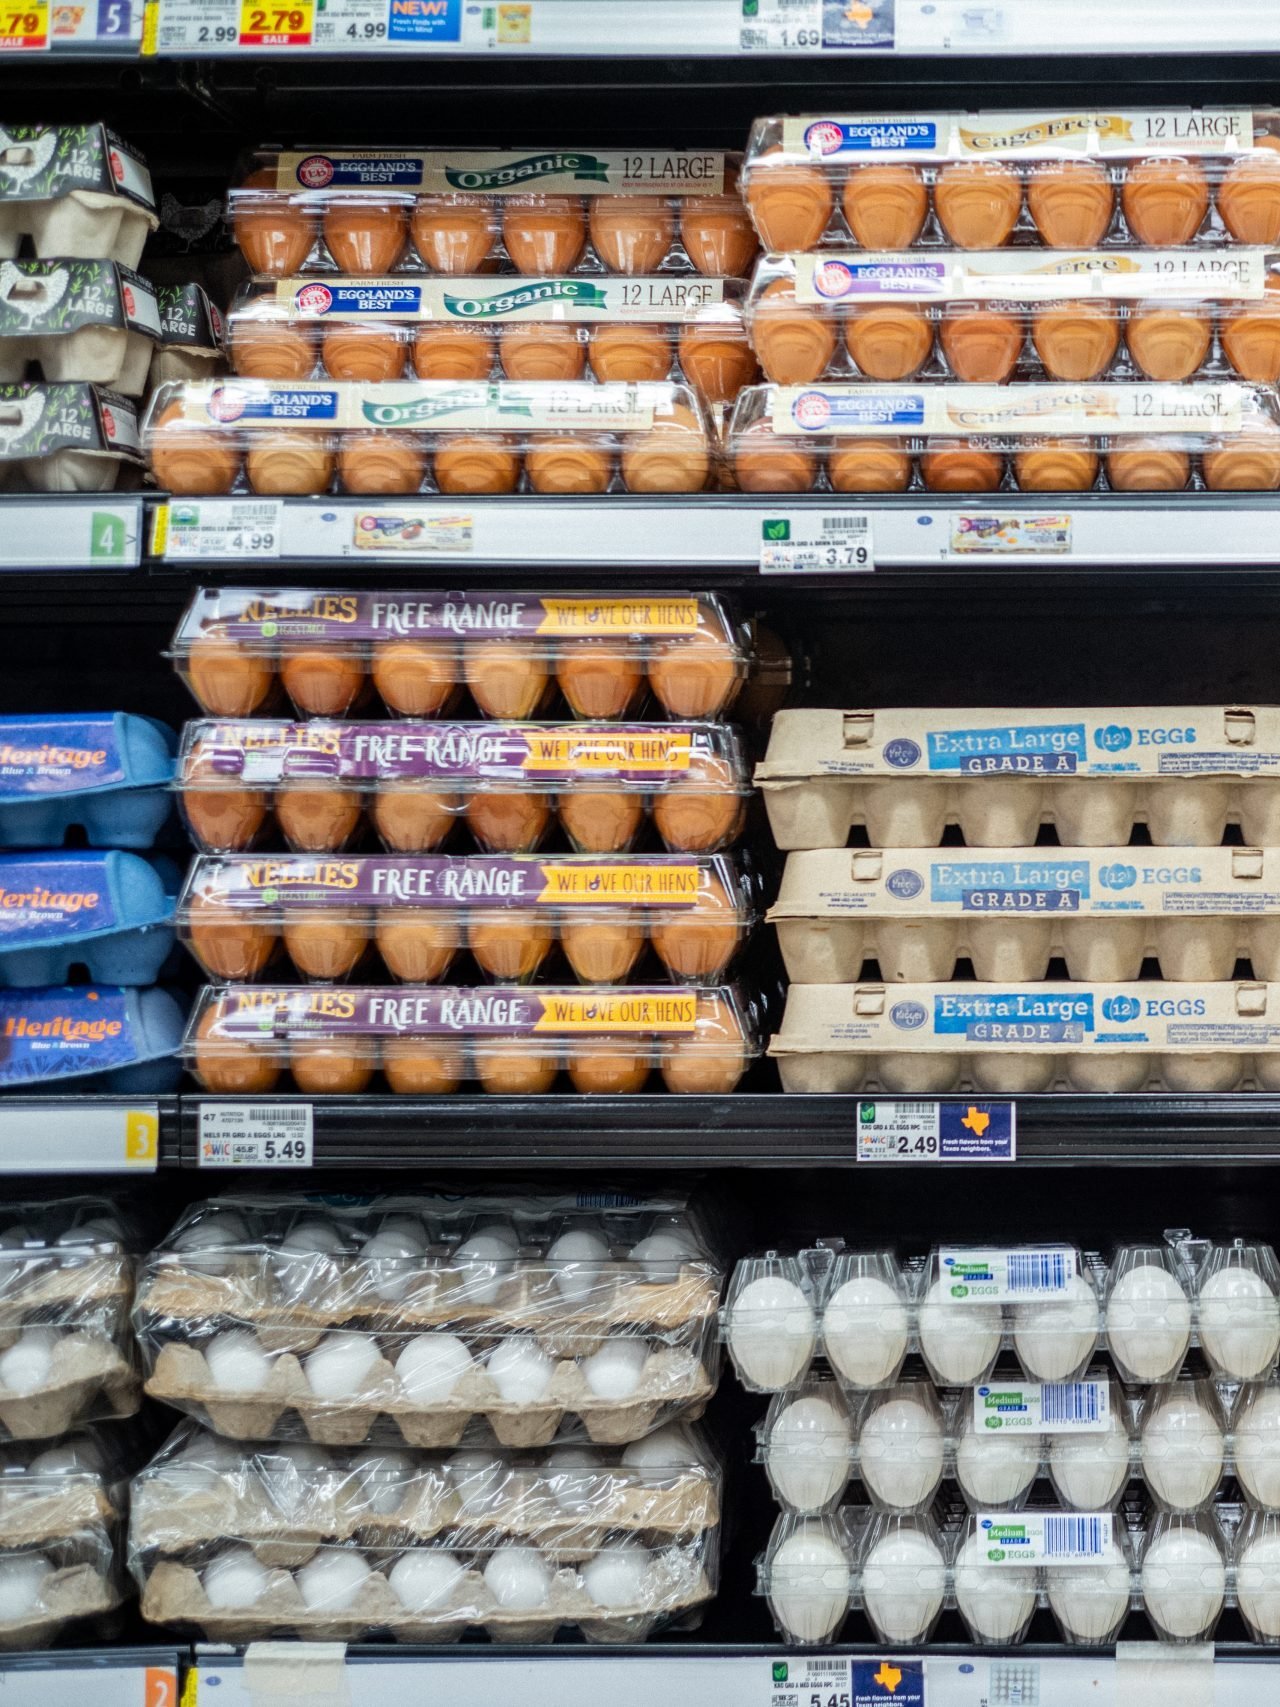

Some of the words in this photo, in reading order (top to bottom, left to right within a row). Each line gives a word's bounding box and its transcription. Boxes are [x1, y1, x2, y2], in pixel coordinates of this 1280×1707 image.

[392, 1, 447, 16] NEW!
[106, 3, 121, 33] 5
[250, 10, 304, 31] 2.79
[198, 27, 237, 42] 2.99
[262, 35, 289, 44] SALE
[346, 23, 386, 38] 4.99
[781, 29, 820, 46] 1.69
[1145, 118, 1166, 138] 12
[1173, 117, 1243, 138] LARGE
[870, 137, 908, 147] BEST
[71, 150, 89, 166] 12
[55, 163, 103, 182] LARGE
[457, 155, 580, 188] Organic
[622, 157, 643, 179] 12
[650, 156, 716, 179] LARGE
[359, 172, 395, 182] BEST
[83, 286, 101, 301] 12
[68, 298, 115, 318] LARGE
[60, 408, 78, 422] 12
[43, 422, 92, 440] LARGE
[99, 524, 114, 550] 4
[232, 533, 274, 551] 4.99
[825, 546, 868, 565] 3.79
[371, 603, 432, 635] FREE
[441, 601, 525, 634] RANGE
[933, 733, 1001, 753] Extra
[1008, 729, 1081, 750] Large
[1105, 732, 1122, 744] 12
[1137, 728, 1196, 745] EGGS
[969, 757, 1044, 772] GRADE
[1056, 756, 1070, 771] A
[372, 868, 433, 900] FREE
[443, 866, 527, 901] RANGE
[556, 874, 577, 891] WE
[623, 873, 652, 892] OUR
[659, 873, 696, 892] HENS
[369, 998, 430, 1030] FREE
[440, 997, 523, 1030] RANGE
[555, 1002, 575, 1022] WE
[620, 1002, 649, 1021] OUR
[656, 1001, 692, 1021] HENS
[941, 998, 1011, 1017] Extra
[1016, 996, 1088, 1020] Large
[1112, 1003, 1131, 1015] 12
[1145, 999, 1206, 1016] EGGS
[5, 1017, 122, 1041] Heritage
[974, 1023, 1050, 1038] GRADE
[1062, 1022, 1076, 1038] A
[31, 1041, 51, 1050] Blue
[59, 1041, 90, 1050] Brown
[135, 1125, 149, 1155] 3
[898, 1136, 937, 1153] 2.49
[942, 1138, 960, 1146] Fresh
[961, 1138, 979, 1146] flavors
[980, 1138, 994, 1146] from
[995, 1138, 1009, 1147] your
[264, 1140, 306, 1159] 5.49
